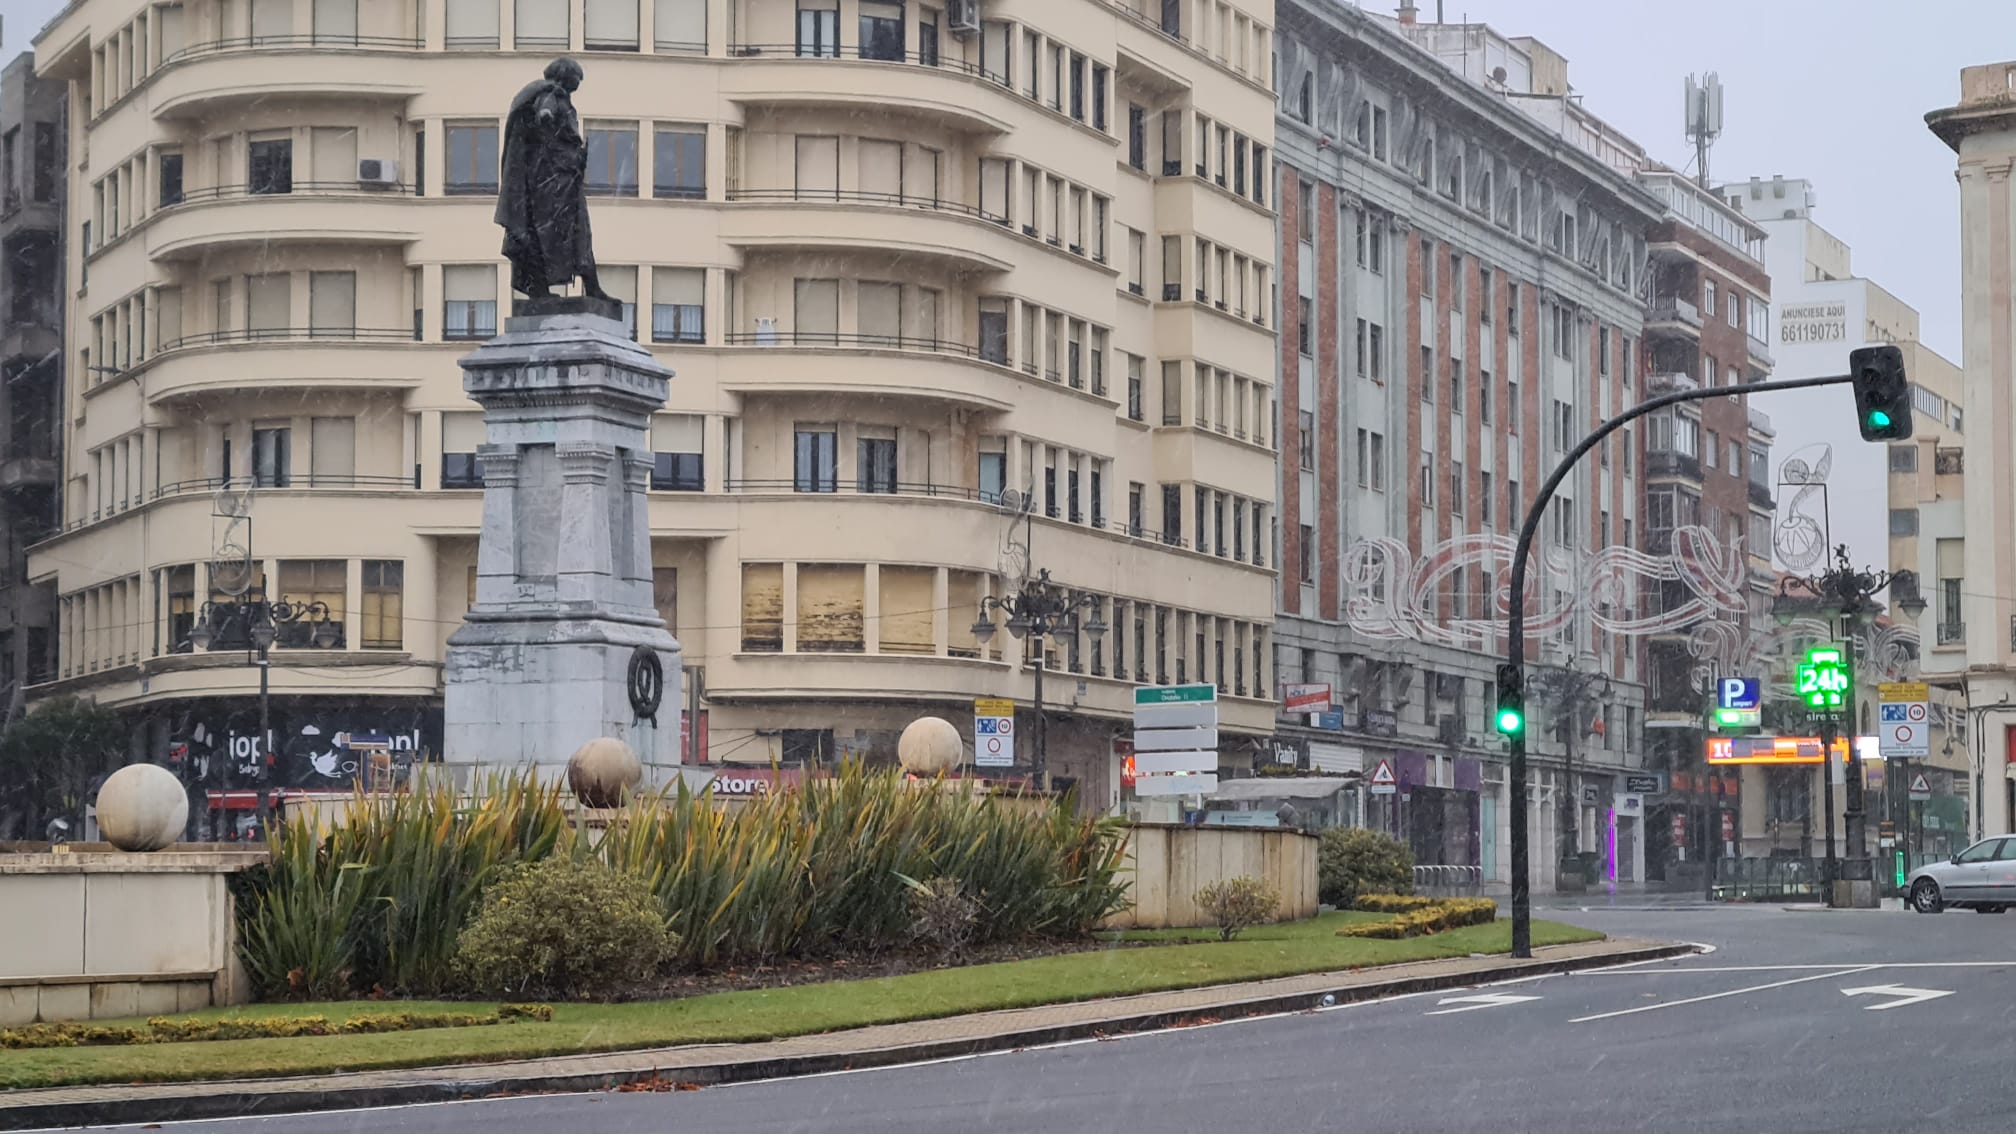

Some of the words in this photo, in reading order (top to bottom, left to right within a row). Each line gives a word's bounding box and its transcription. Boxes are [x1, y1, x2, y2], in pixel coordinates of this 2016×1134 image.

[1781, 306, 1824, 319] ANUNCIESE
[1827, 305, 1846, 317] AQUI
[1781, 322, 1846, 342] 661190731
[1800, 668, 1848, 692] 24h
[1806, 712, 1839, 721] sirea
[1273, 742, 1298, 767] Vanity
[712, 774, 769, 793] Store
